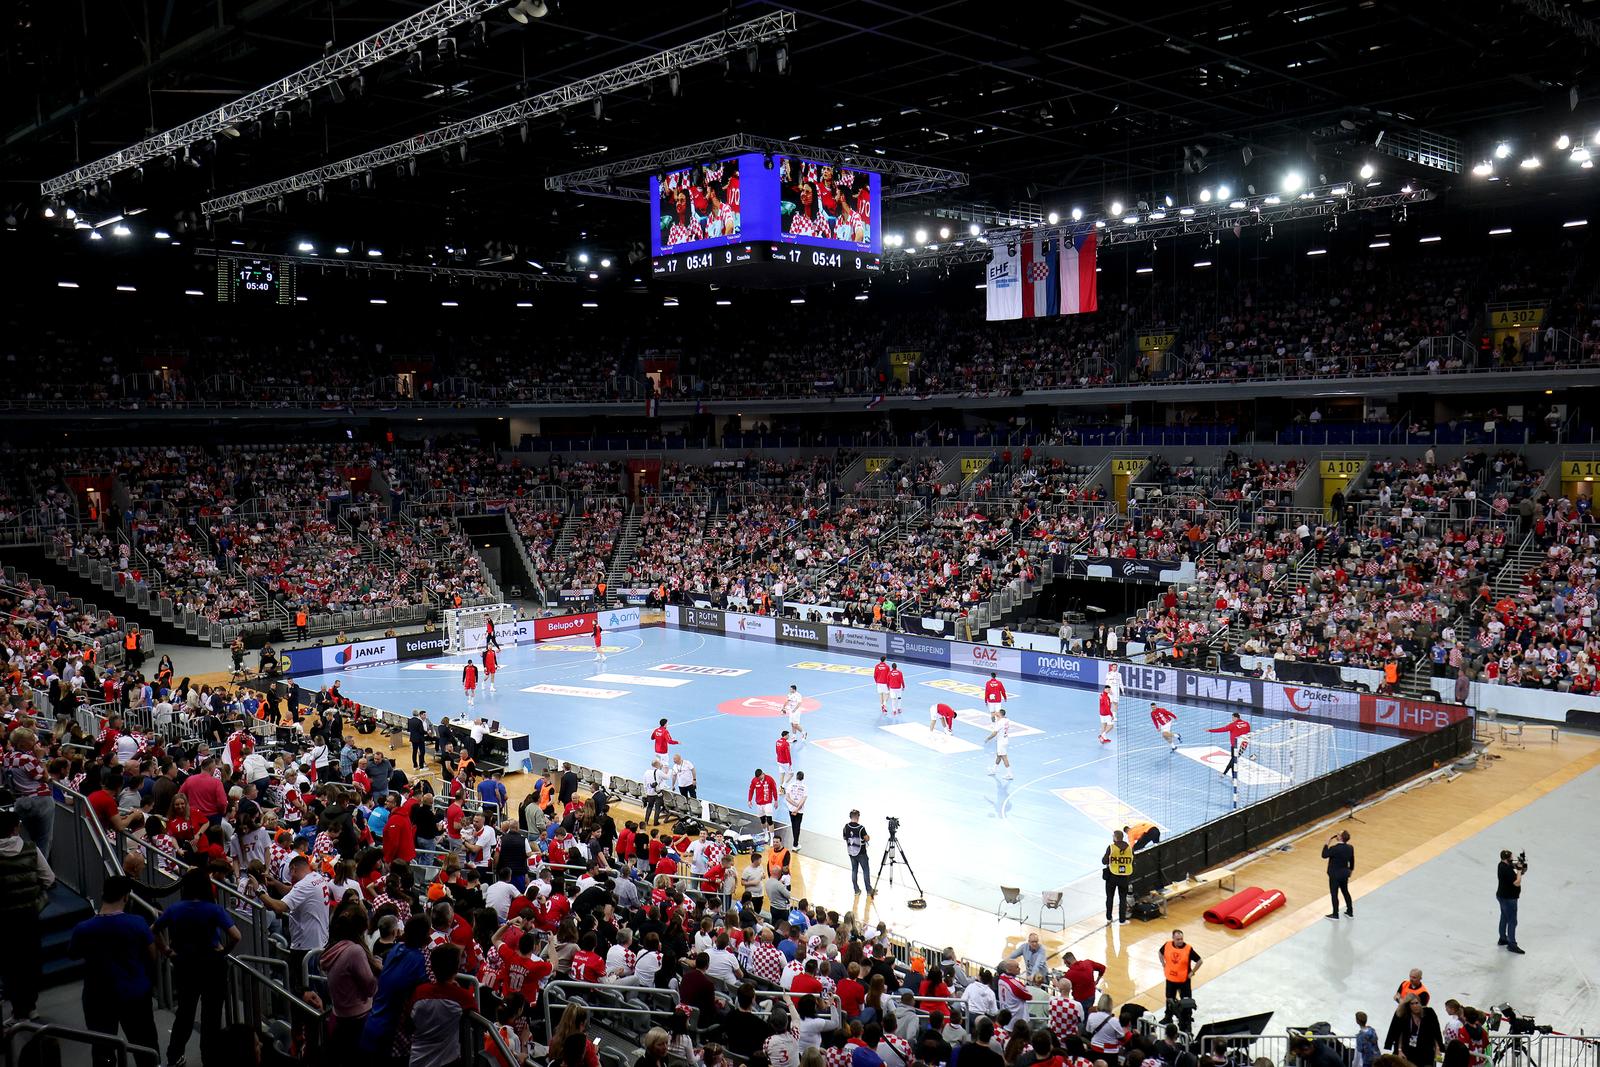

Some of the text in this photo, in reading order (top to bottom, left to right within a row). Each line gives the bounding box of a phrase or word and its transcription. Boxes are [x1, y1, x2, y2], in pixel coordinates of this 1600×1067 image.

[668, 260, 677, 272] 17
[686, 253, 712, 270] 05:41
[726, 251, 732, 264] 9
[789, 250, 801, 262] 17
[812, 252, 841, 268] 05:41
[856, 258, 861, 270] 9
[990, 262, 1009, 277] EHF
[240, 271, 251, 280] 17
[266, 273, 273, 282] 9
[246, 282, 269, 291] 05:40
[1500, 311, 1535, 323] A 302
[1145, 338, 1150, 346] A
[966, 460, 971, 468] A
[1118, 461, 1124, 470] A
[1328, 462, 1360, 473] A 103
[1571, 463, 1580, 475] A
[699, 612, 718, 621] ROTIM
[548, 622, 574, 631] Belupo
[406, 638, 450, 651] telemac
[906, 643, 944, 654] BAUERFEIND
[356, 646, 385, 658] JANAF
[973, 647, 997, 660] GAZ
[973, 660, 997, 668] nutrition
[1038, 657, 1080, 671] molten
[1403, 708, 1449, 728] HPB
[176, 822, 188, 832] 18
[572, 962, 585, 980] 51
[779, 1050, 789, 1062] 3
